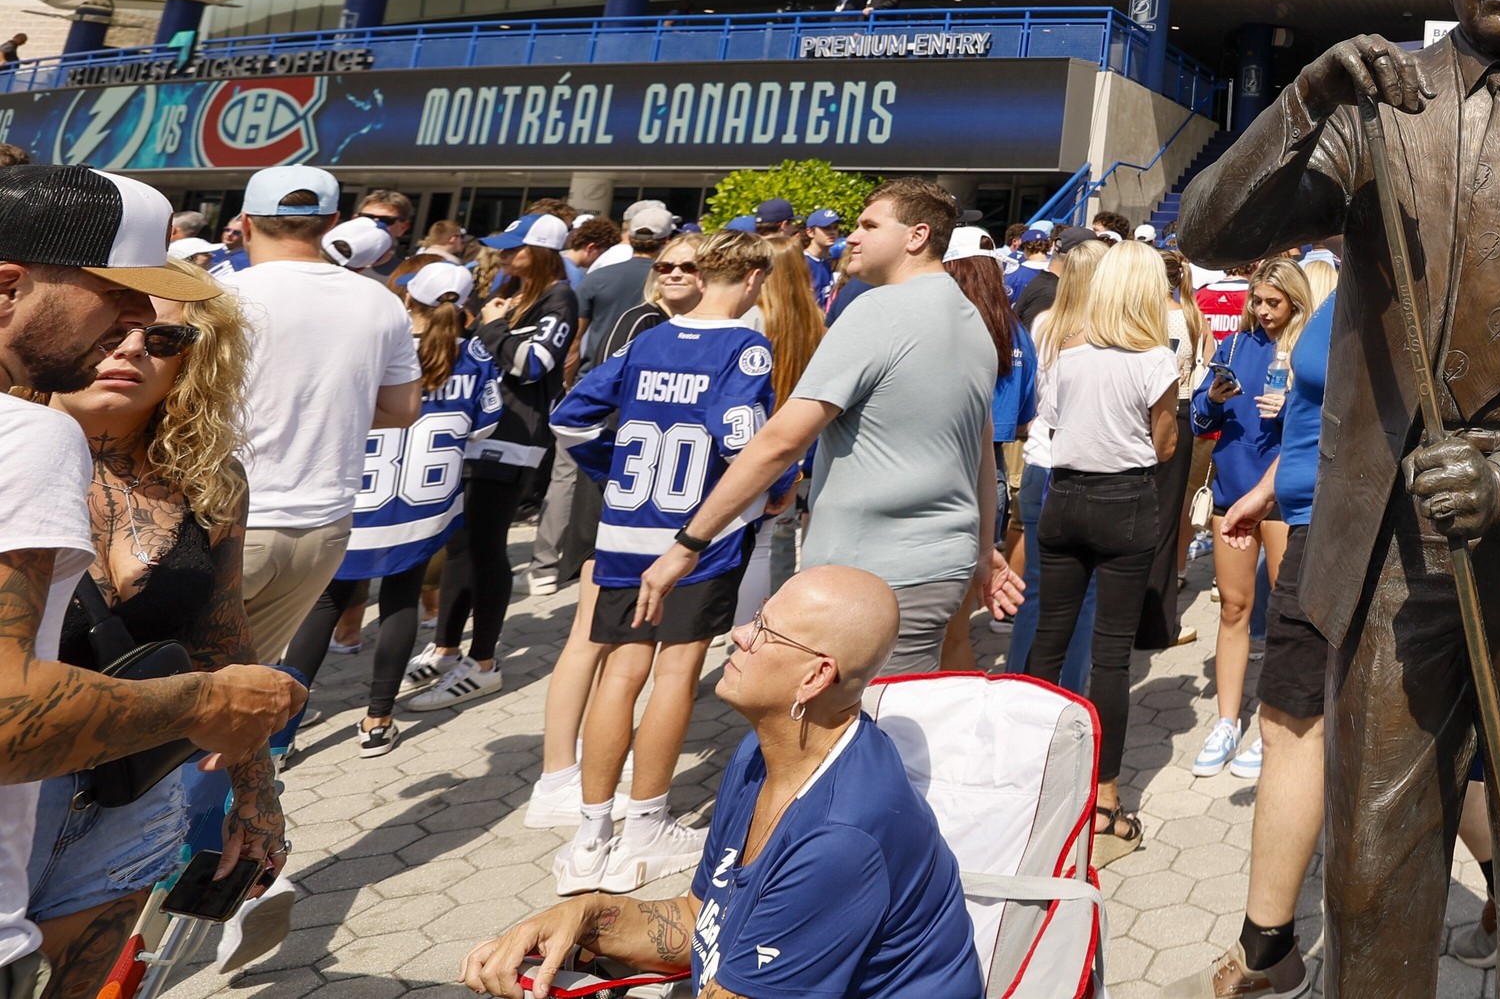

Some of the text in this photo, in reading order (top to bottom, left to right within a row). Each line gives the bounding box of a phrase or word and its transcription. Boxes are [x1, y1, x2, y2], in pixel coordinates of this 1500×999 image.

[799, 32, 991, 58] PREMIUM ENTRY
[1433, 29, 1450, 37] BA
[66, 48, 368, 86] RELIAQUEST TICKET OFFICE
[415, 72, 897, 145] MONTRÉAL CANADIENS
[532, 316, 571, 349] 38
[636, 370, 711, 405] BISHOP
[352, 411, 473, 512] 86
[603, 419, 712, 513] 30
